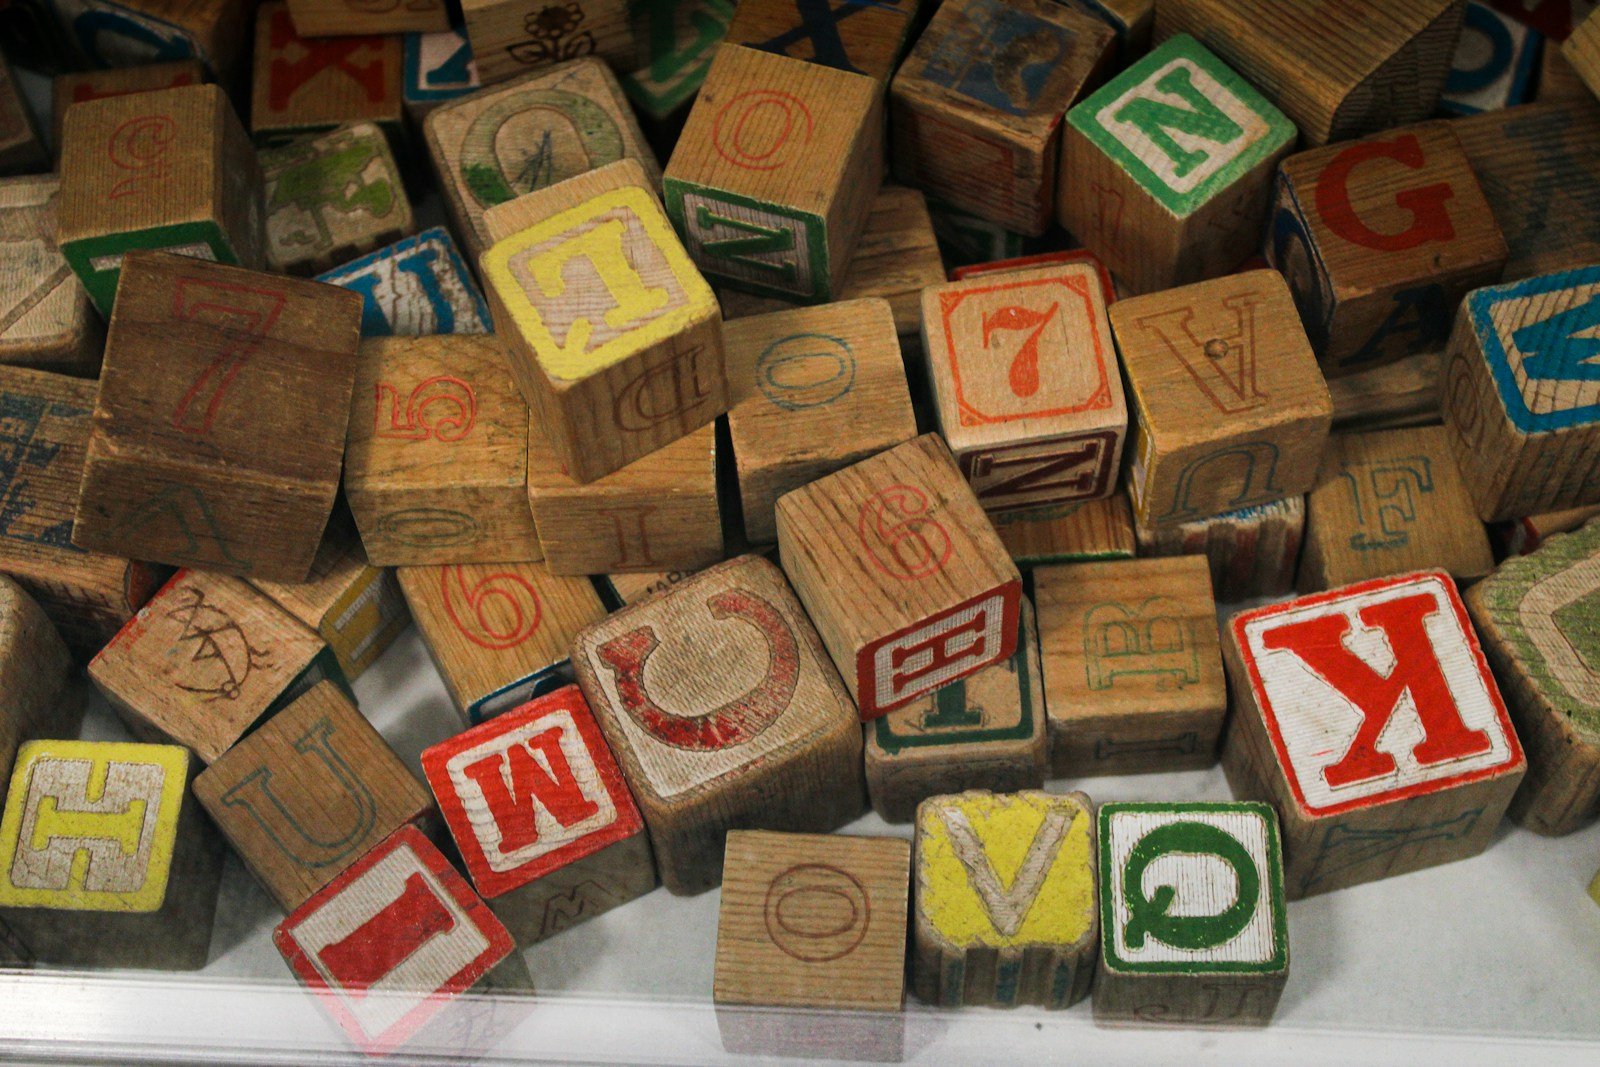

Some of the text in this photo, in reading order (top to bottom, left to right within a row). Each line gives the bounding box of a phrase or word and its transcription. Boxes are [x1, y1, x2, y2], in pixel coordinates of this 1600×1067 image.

[713, 90, 812, 170] O
[1113, 67, 1242, 178] N
[1315, 134, 1455, 251] G
[172, 277, 285, 433] 7
[982, 302, 1059, 397] 7
[375, 375, 476, 442] 5
[858, 485, 952, 580] 6
[441, 564, 542, 650] 6
[1086, 595, 1199, 690] B
[1262, 593, 1491, 788] K
[221, 716, 378, 869] U
[764, 863, 870, 962] O
[939, 804, 1077, 936] V
